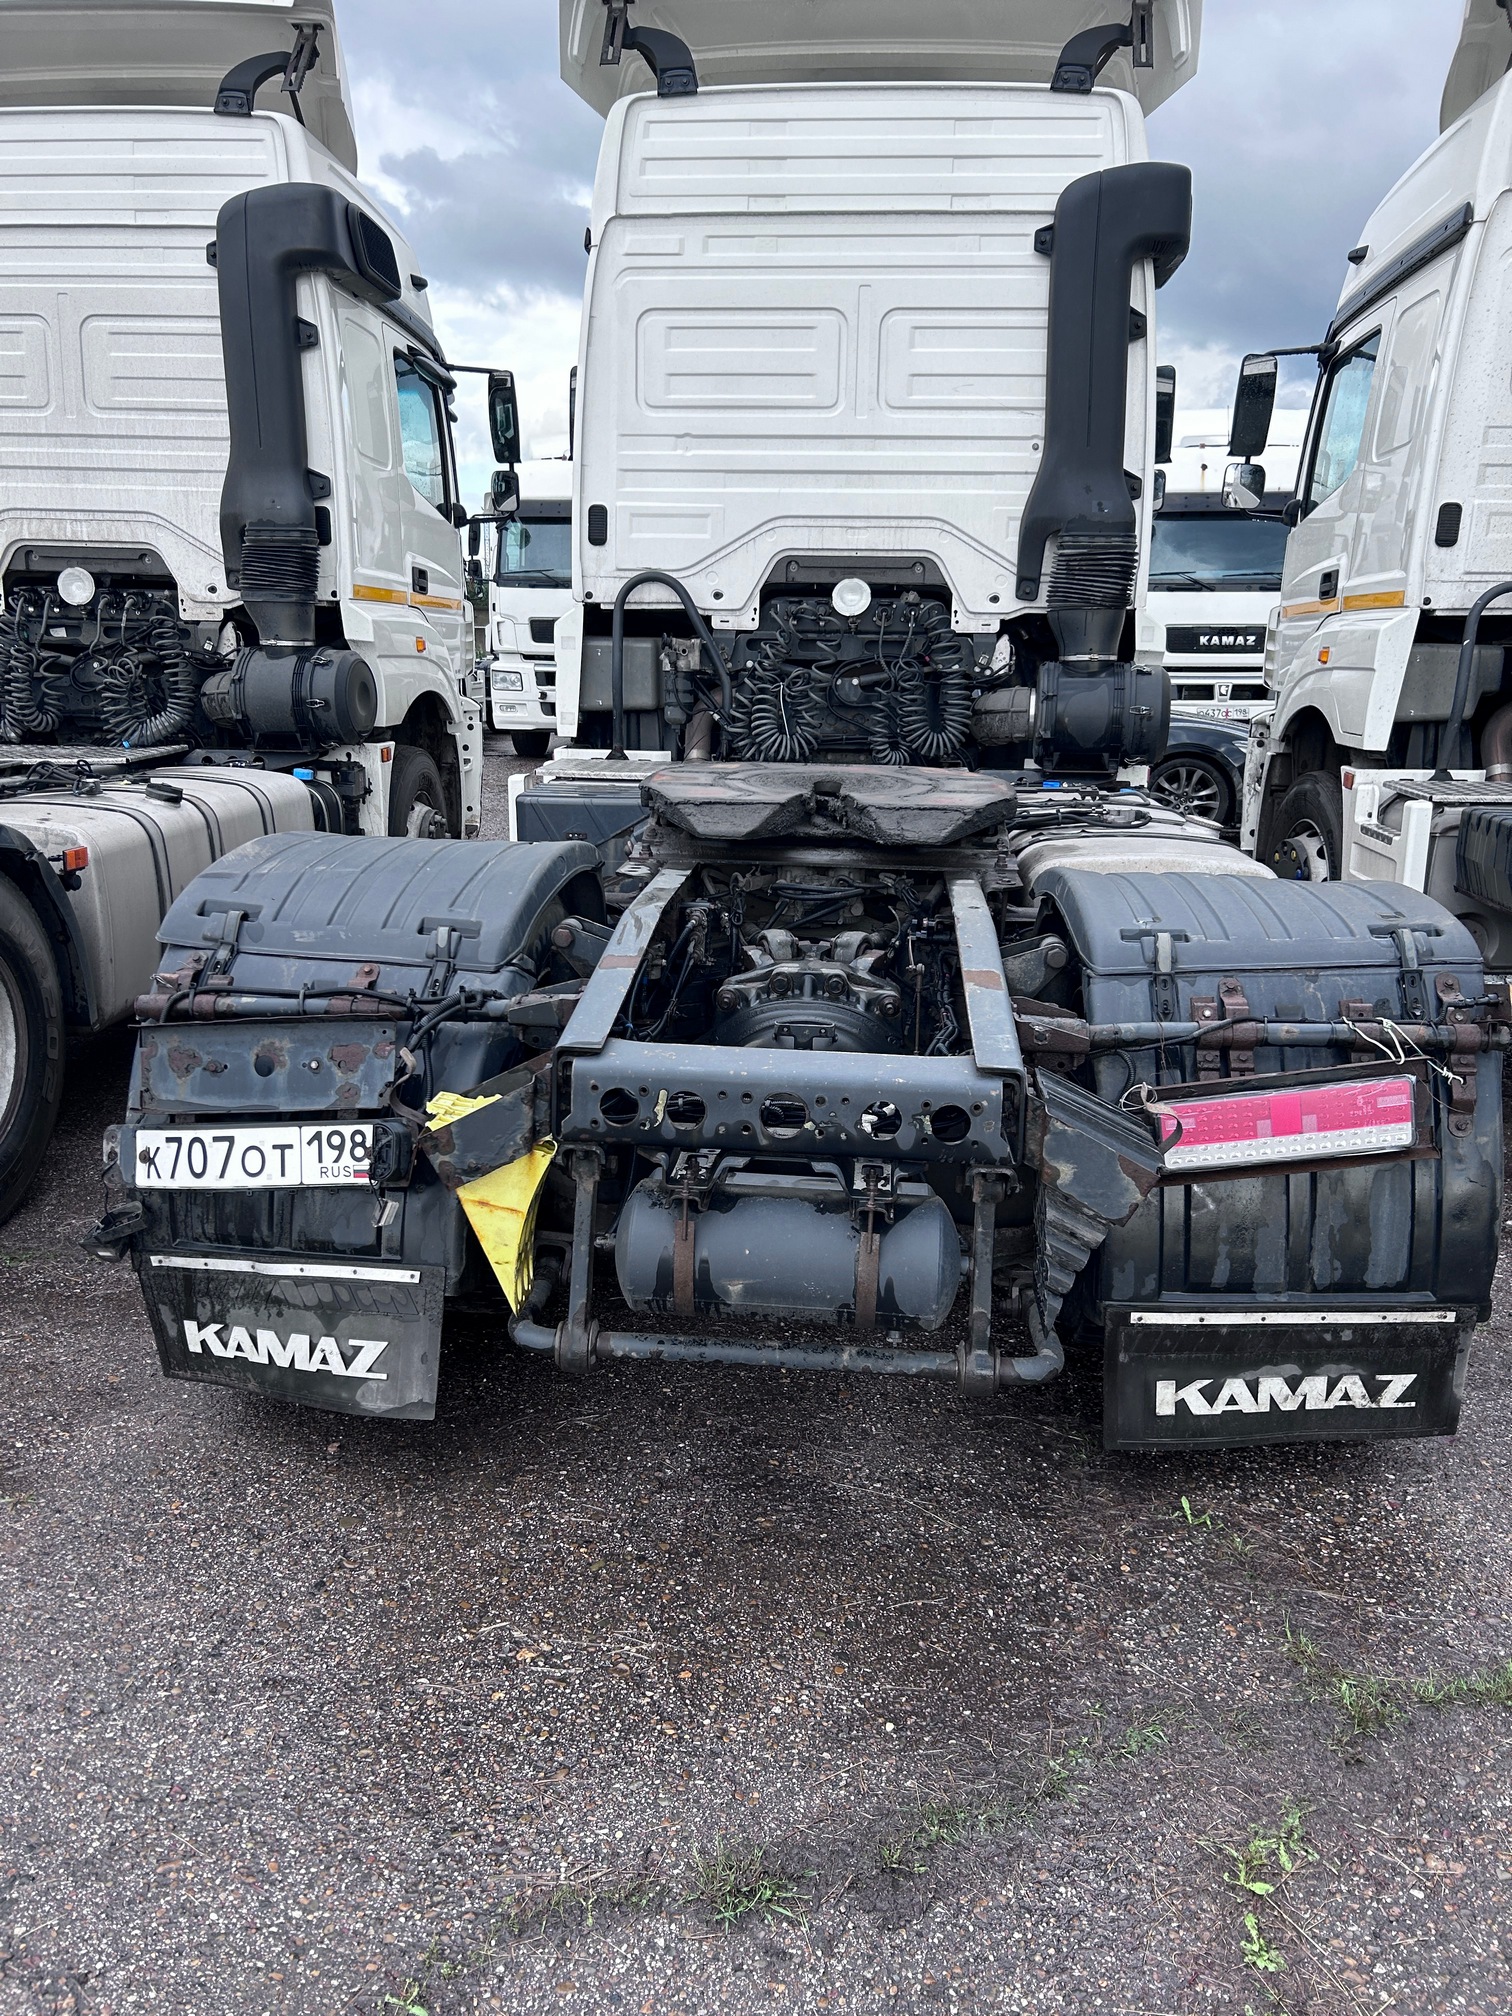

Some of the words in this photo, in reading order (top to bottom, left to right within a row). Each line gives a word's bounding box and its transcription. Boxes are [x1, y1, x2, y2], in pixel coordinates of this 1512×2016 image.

[1199, 635, 1257, 646] KAMAZ
[306, 1129, 367, 1164] 198
[320, 1165, 352, 1178] RUS
[183, 1320, 389, 1380] KAMAZ
[1155, 1374, 1418, 1416] KAMAZ
